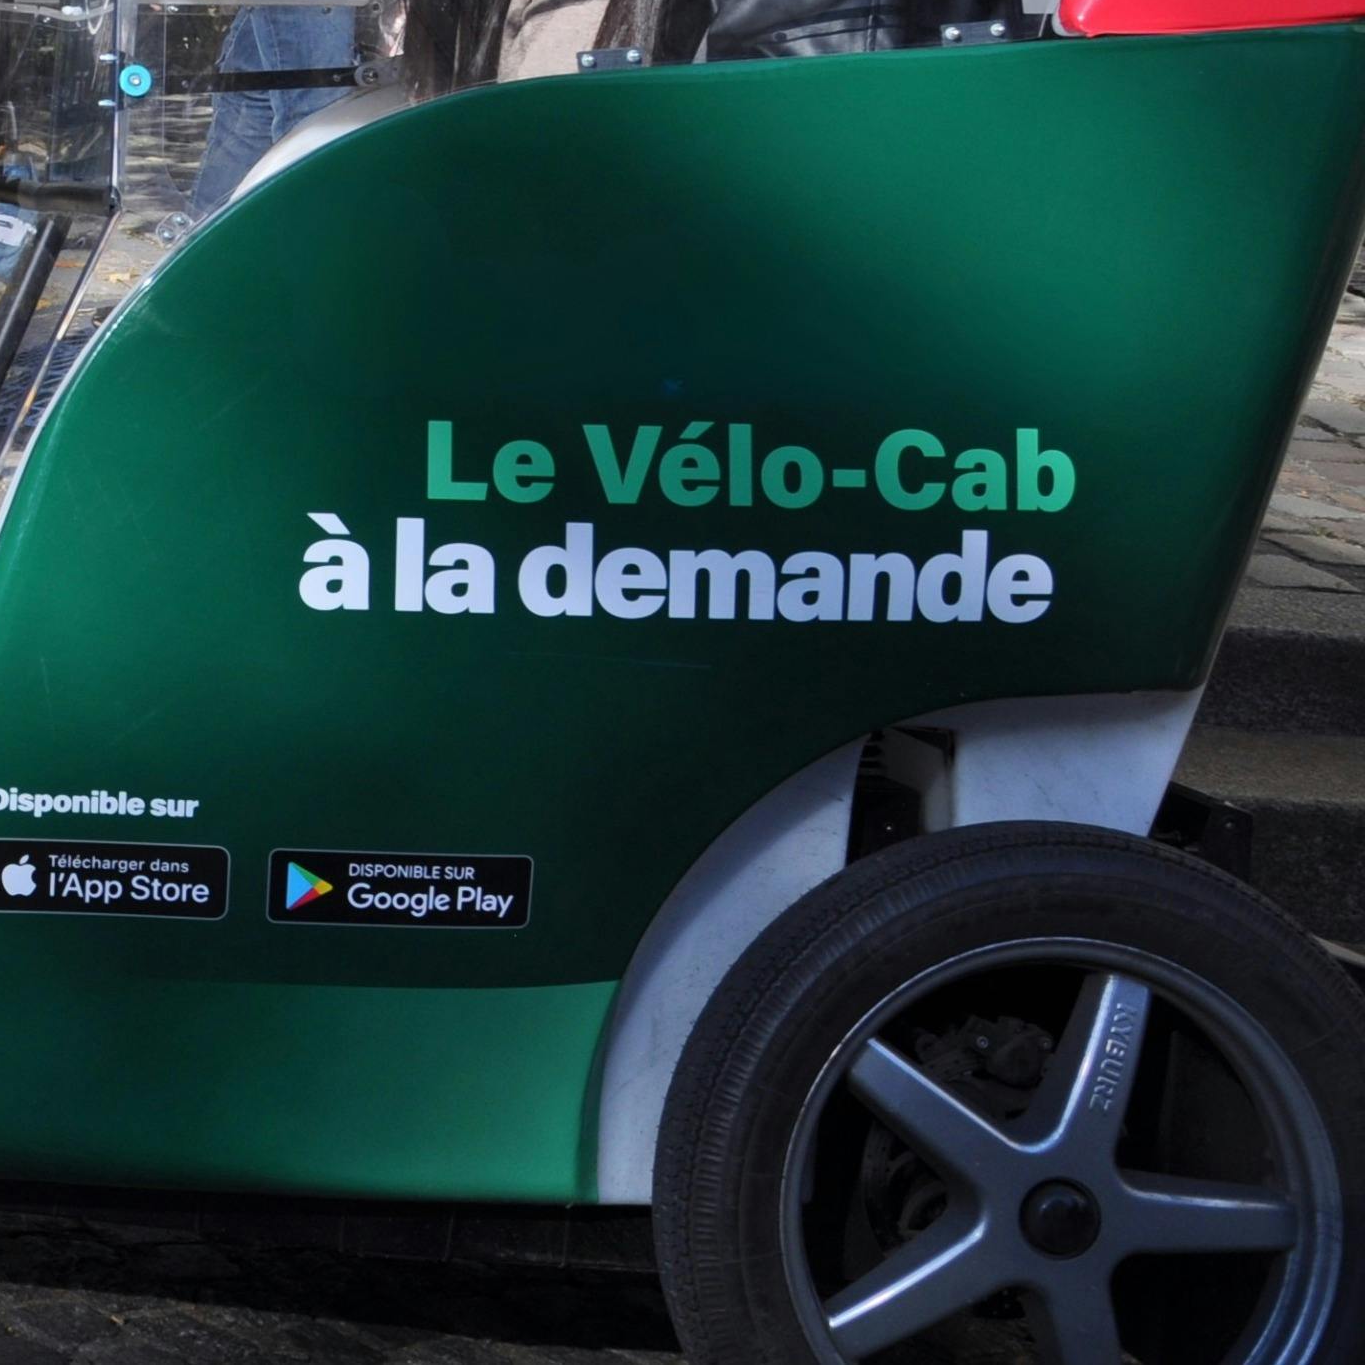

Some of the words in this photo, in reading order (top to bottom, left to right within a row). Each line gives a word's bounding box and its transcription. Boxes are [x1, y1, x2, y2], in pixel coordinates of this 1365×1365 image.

[426, 420, 556, 503] Le
[582, 421, 1077, 513] Vélo-Cab
[298, 512, 371, 612] à
[394, 517, 496, 614] la
[517, 522, 1055, 624] demande
[150, 798, 200, 818] sur
[48, 854, 145, 873] Télécharger
[150, 858, 189, 873] dans
[348, 863, 440, 879] DISPONIBLE
[444, 866, 475, 880] SUR
[49, 872, 123, 904] l'App
[130, 874, 210, 903] Store
[347, 882, 451, 918] Google
[457, 885, 514, 918] Play
